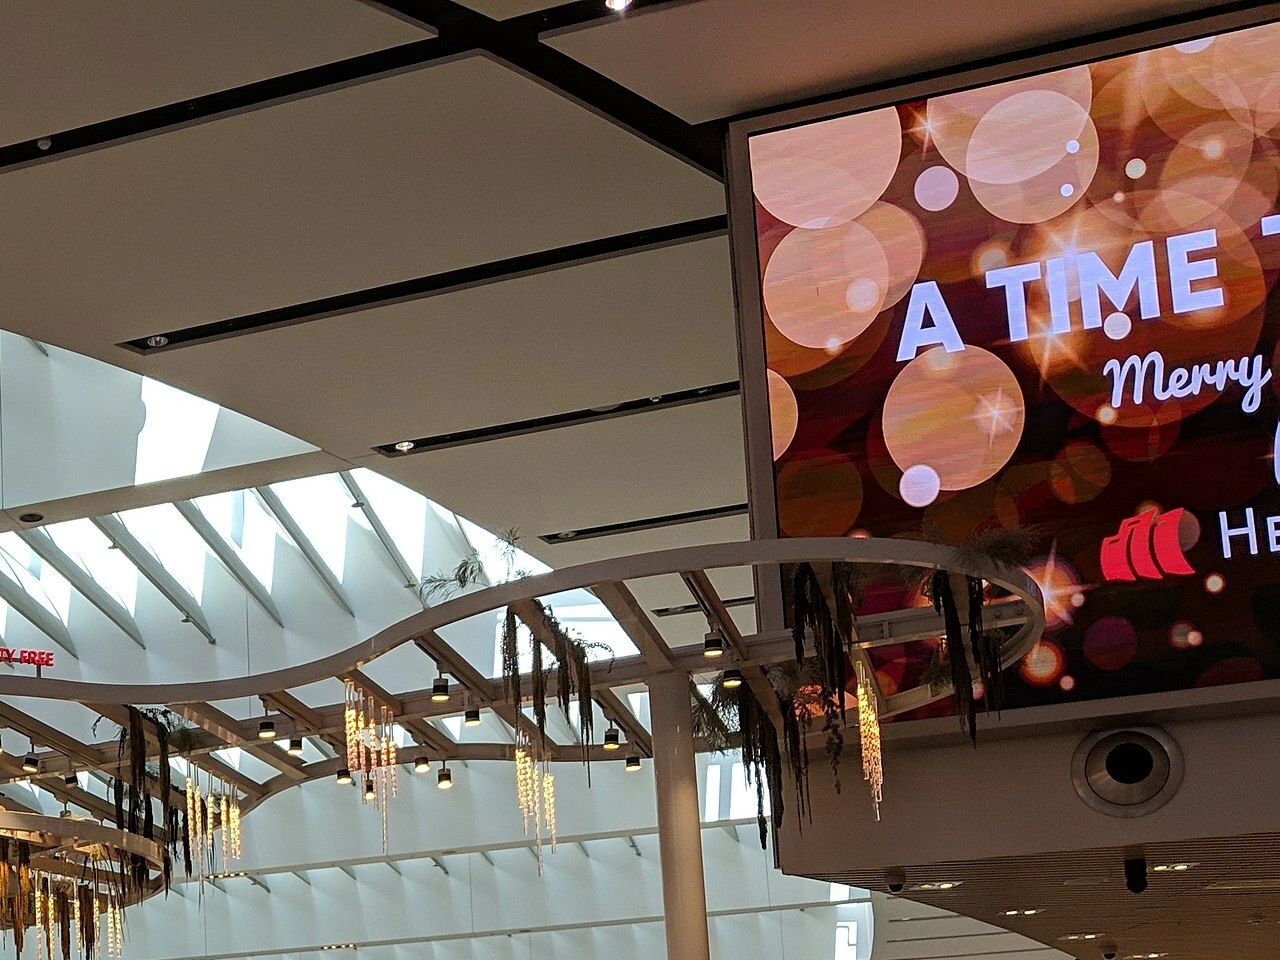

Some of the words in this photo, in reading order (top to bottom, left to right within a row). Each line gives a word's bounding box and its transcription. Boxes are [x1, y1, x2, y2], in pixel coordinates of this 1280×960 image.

[896, 281, 965, 362] A
[985, 228, 1224, 342] TIME
[1102, 350, 1272, 413] Merry
[19, 650, 54, 667] FREE
